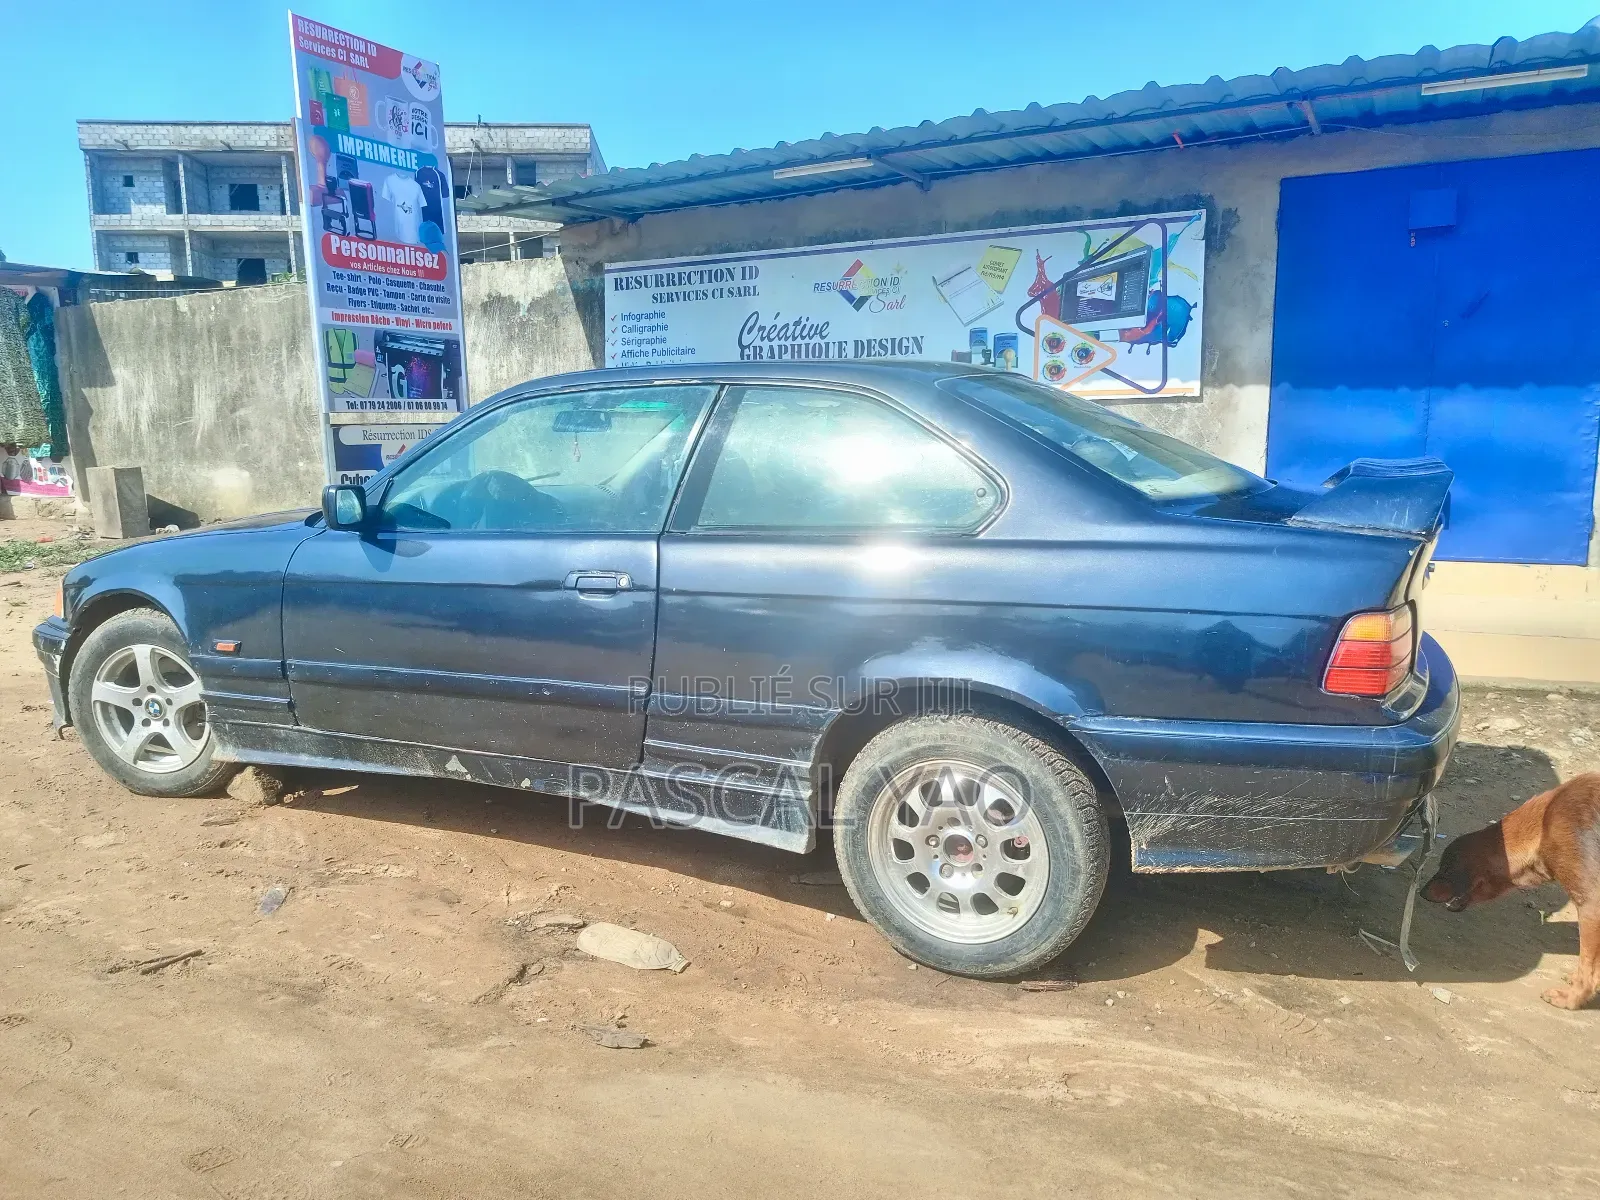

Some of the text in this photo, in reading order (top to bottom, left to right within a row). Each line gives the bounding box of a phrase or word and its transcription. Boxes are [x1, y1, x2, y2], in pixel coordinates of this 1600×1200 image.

[297, 18, 377, 57] RESURRECTION ID
[299, 35, 369, 69] Services CI SARL
[411, 121, 428, 140] ICI
[337, 133, 418, 170] IMPRIMERIE
[330, 234, 440, 269] Personnalisez
[362, 262, 385, 273] Articles
[387, 265, 400, 275] chez
[401, 267, 416, 277] Nous
[613, 265, 760, 292] RESURRECTION ID
[347, 272, 362, 282] shirt
[369, 276, 381, 285] Polo
[385, 278, 415, 290] Casquette
[419, 281, 445, 292] Chasuble
[889, 276, 900, 287] ID
[326, 282, 451, 304] Reçu Badge PVC Tampon Carte de visite
[652, 285, 760, 304] SERVICES CI SARL
[869, 292, 906, 313] Sarl
[348, 297, 367, 309] Flyers
[371, 300, 397, 311] Etiquette
[400, 302, 420, 313] Sachet
[331, 311, 369, 324] Impression
[370, 313, 391, 326] Bâche
[395, 317, 411, 328] Vinyl
[415, 318, 432, 330] Micro
[620, 310, 666, 323] Infographie
[621, 322, 669, 335] Calligraphie
[737, 310, 830, 350] Créative
[620, 335, 667, 348] Sérigraphie
[853, 335, 925, 358] DESIGN
[620, 346, 696, 359] Affiche Publicitaire
[346, 400, 359, 410] Tel:
[360, 400, 367, 410] 07
[369, 400, 377, 410] 79
[377, 400, 386, 410] 24
[362, 429, 416, 441] Résurrection
